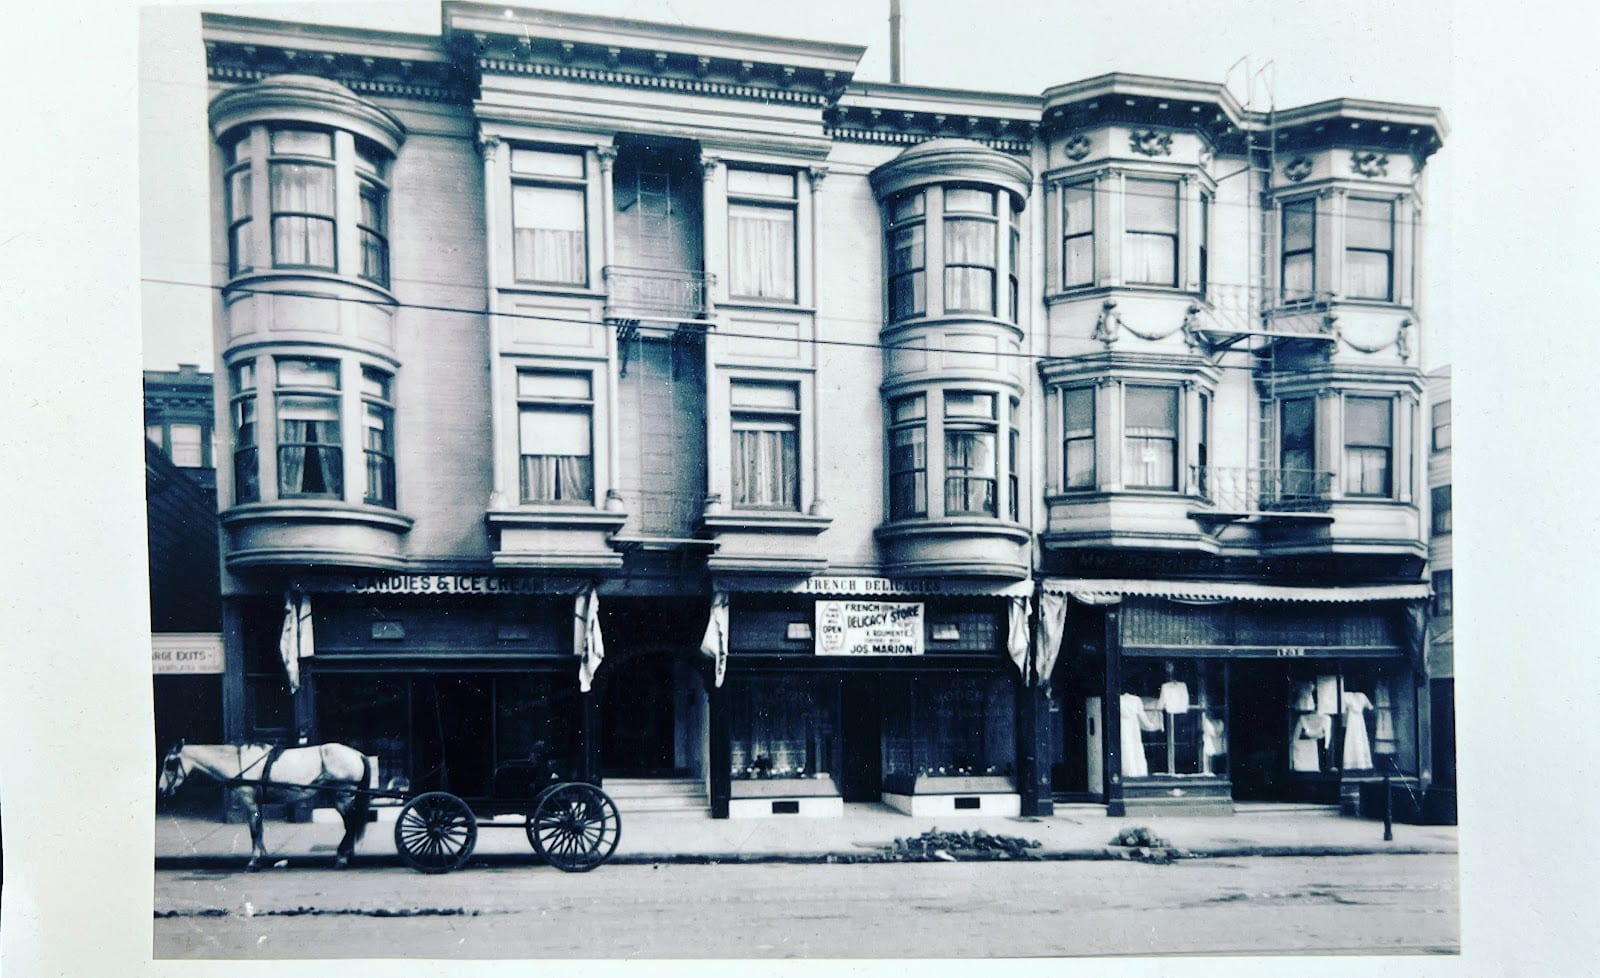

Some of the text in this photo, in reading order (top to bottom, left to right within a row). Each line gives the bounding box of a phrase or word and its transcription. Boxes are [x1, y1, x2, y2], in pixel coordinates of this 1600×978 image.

[354, 575, 431, 591] CANDIES
[437, 575, 450, 591] &
[454, 575, 481, 591] ICE
[805, 578, 941, 592] FRENCH DELICACIES
[845, 603, 880, 612] FRENCH
[847, 604, 920, 629] DELICACY STORE
[823, 625, 842, 634] OPEN
[850, 644, 868, 654] JOS
[872, 644, 913, 654] MARION
